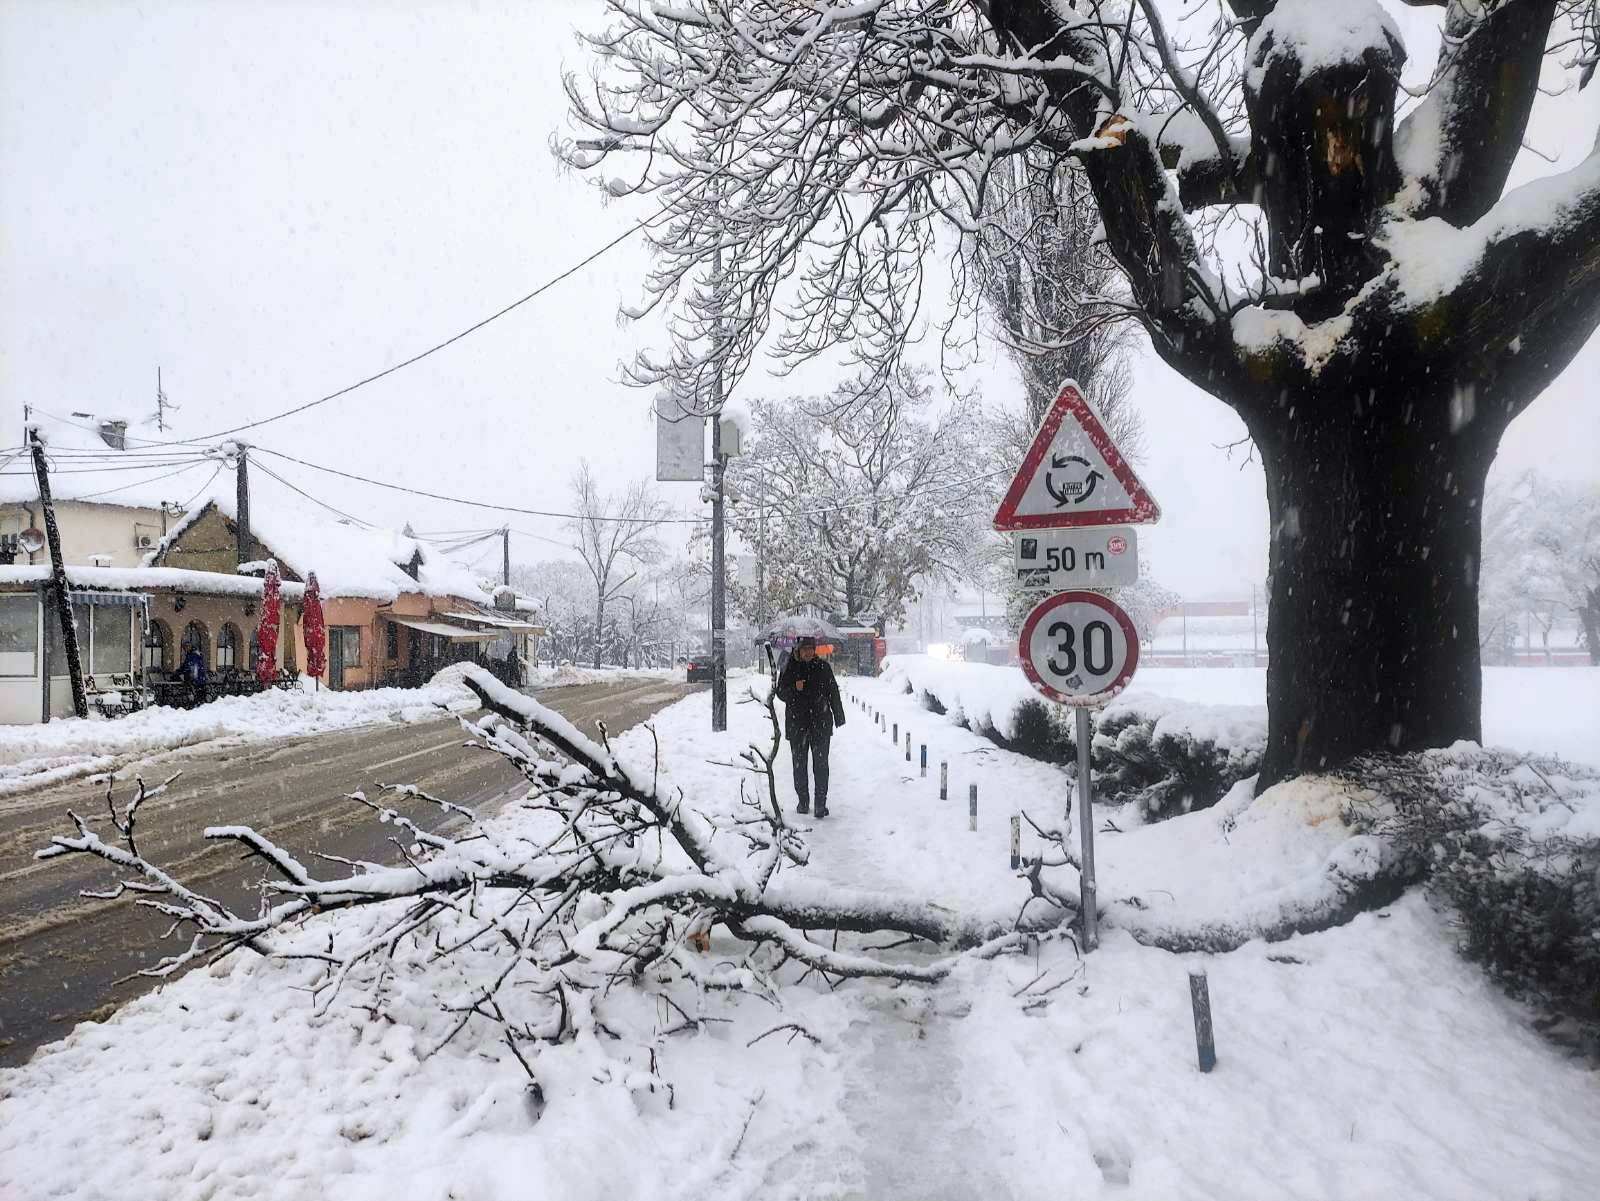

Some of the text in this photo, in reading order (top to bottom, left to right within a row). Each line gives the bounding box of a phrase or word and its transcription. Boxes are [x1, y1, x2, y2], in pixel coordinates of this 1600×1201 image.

[1046, 547, 1105, 572] 50 m
[1047, 620, 1114, 676] 30
